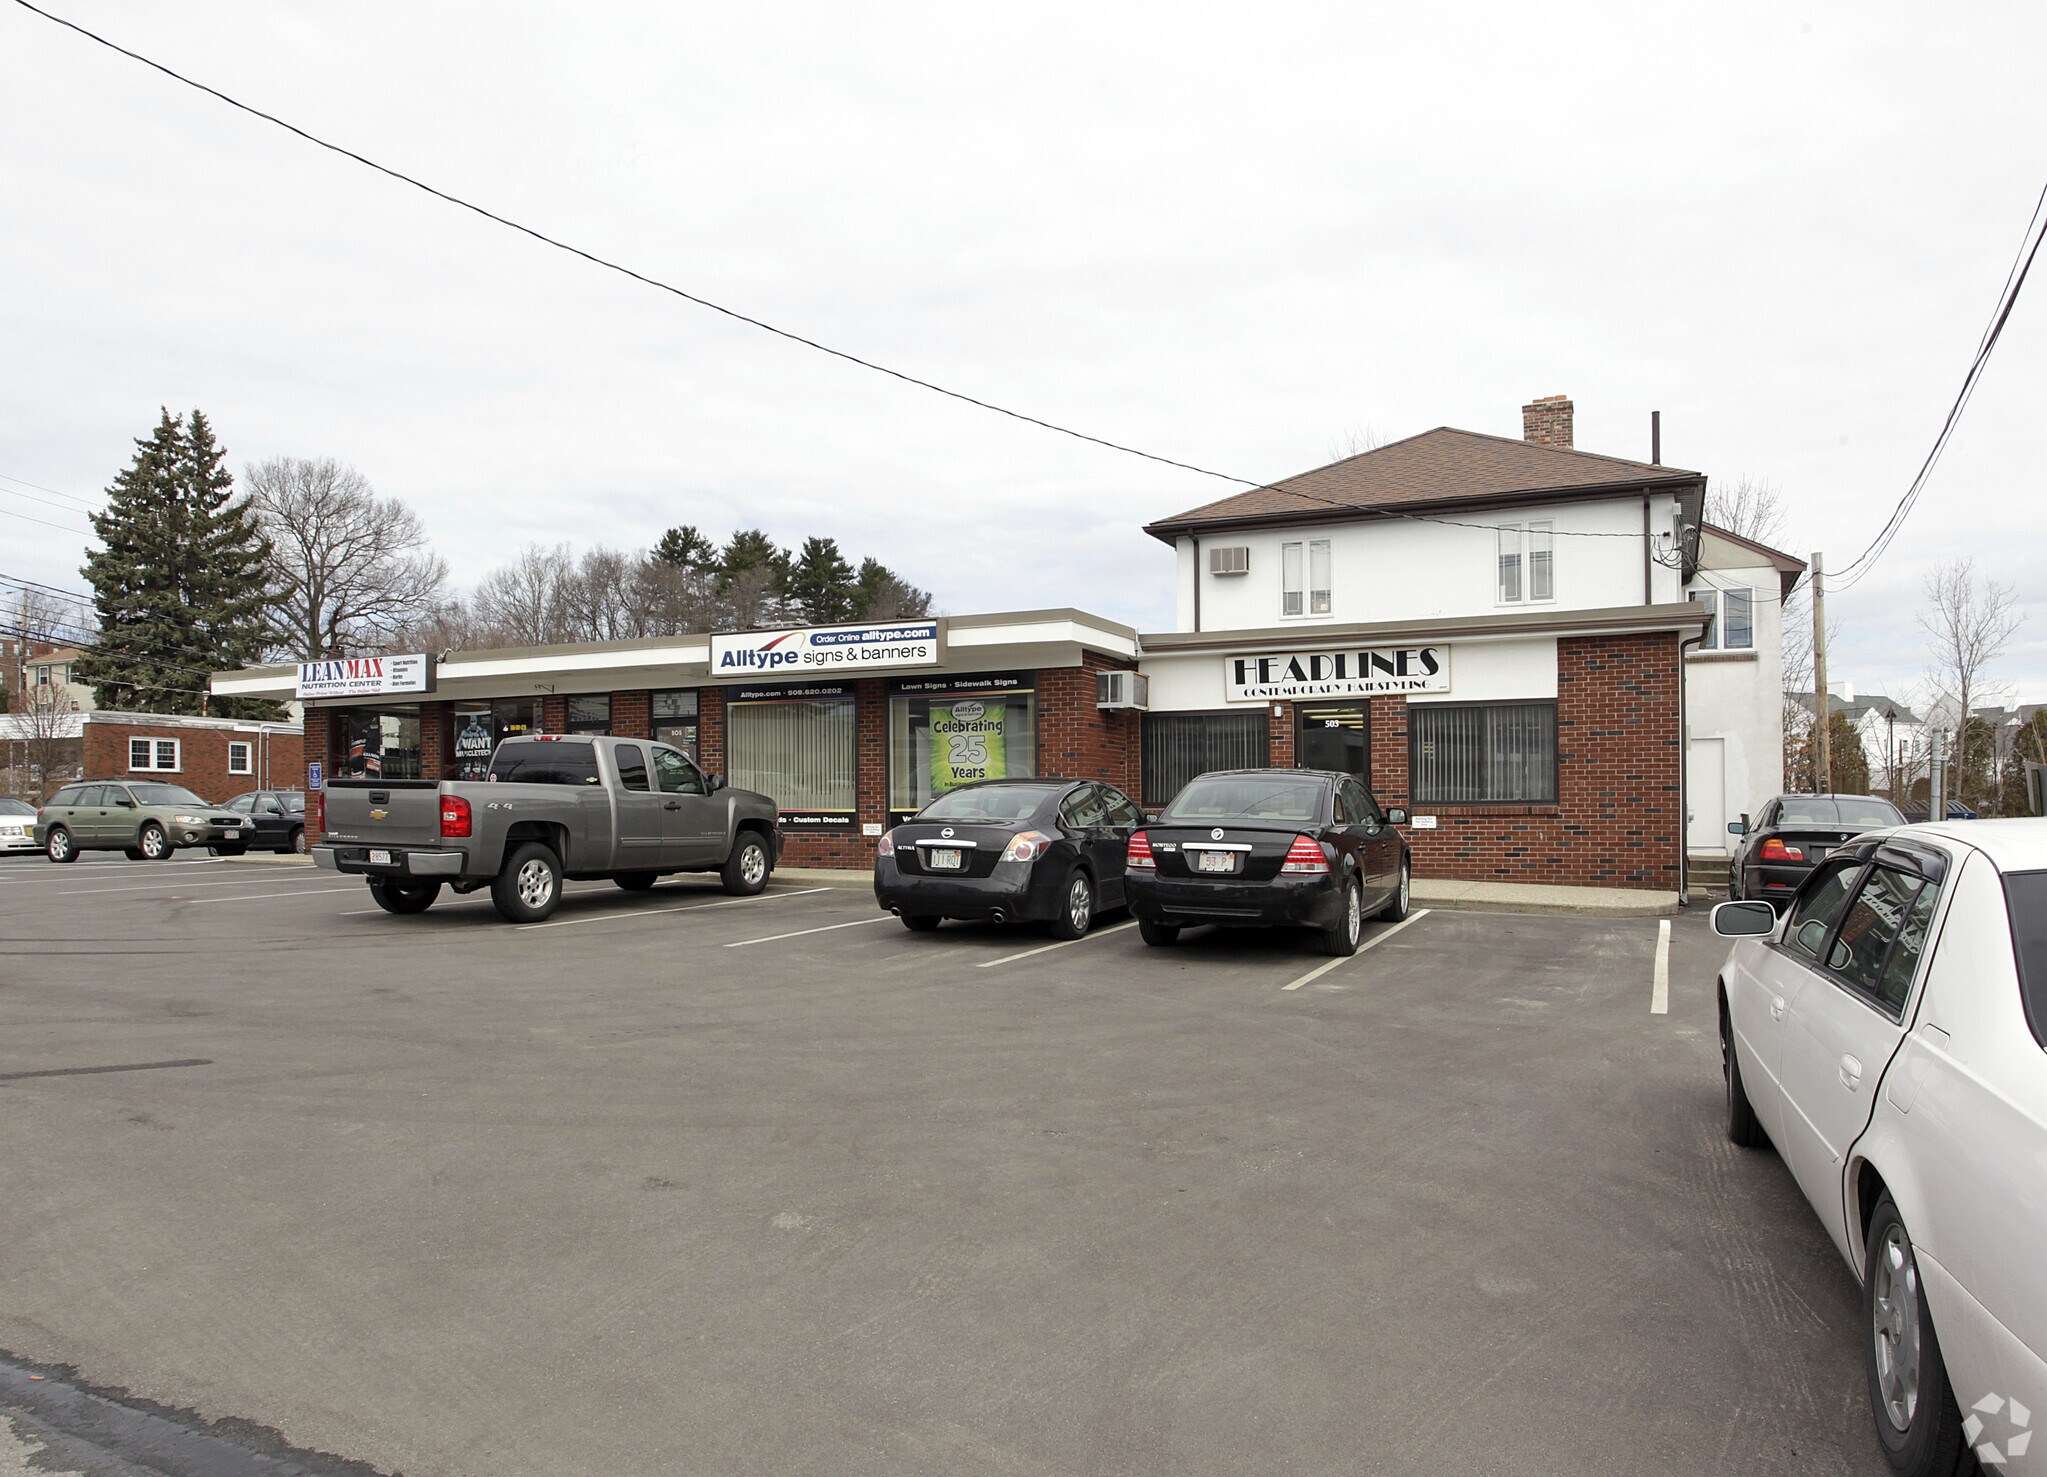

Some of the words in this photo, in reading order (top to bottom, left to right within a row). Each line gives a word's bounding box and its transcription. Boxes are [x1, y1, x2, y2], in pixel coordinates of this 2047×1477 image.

[816, 635, 837, 644] Order
[838, 633, 860, 643] Online
[861, 629, 930, 642] alltype.com
[720, 649, 799, 669] Alltype
[803, 649, 843, 666] signs
[846, 647, 858, 661] &
[861, 645, 927, 660] banners
[1234, 647, 1440, 685] HEADLINES
[302, 681, 347, 690] NUTRITION
[349, 680, 382, 688] CENTER
[924, 682, 947, 690] Signs
[954, 680, 992, 688] Sidewalk
[994, 679, 1018, 687] Signs
[1244, 683, 1342, 697] CONTEMPORARY
[1347, 680, 1430, 693] HAIRSTYLING
[740, 689, 781, 698] Alltype.com
[787, 687, 842, 696] 508.620.0202
[933, 719, 1003, 736] Celebrating
[1325, 719, 1340, 728] 503
[463, 736, 492, 750] WANT
[947, 735, 988, 764] 25
[951, 767, 985, 779] Years
